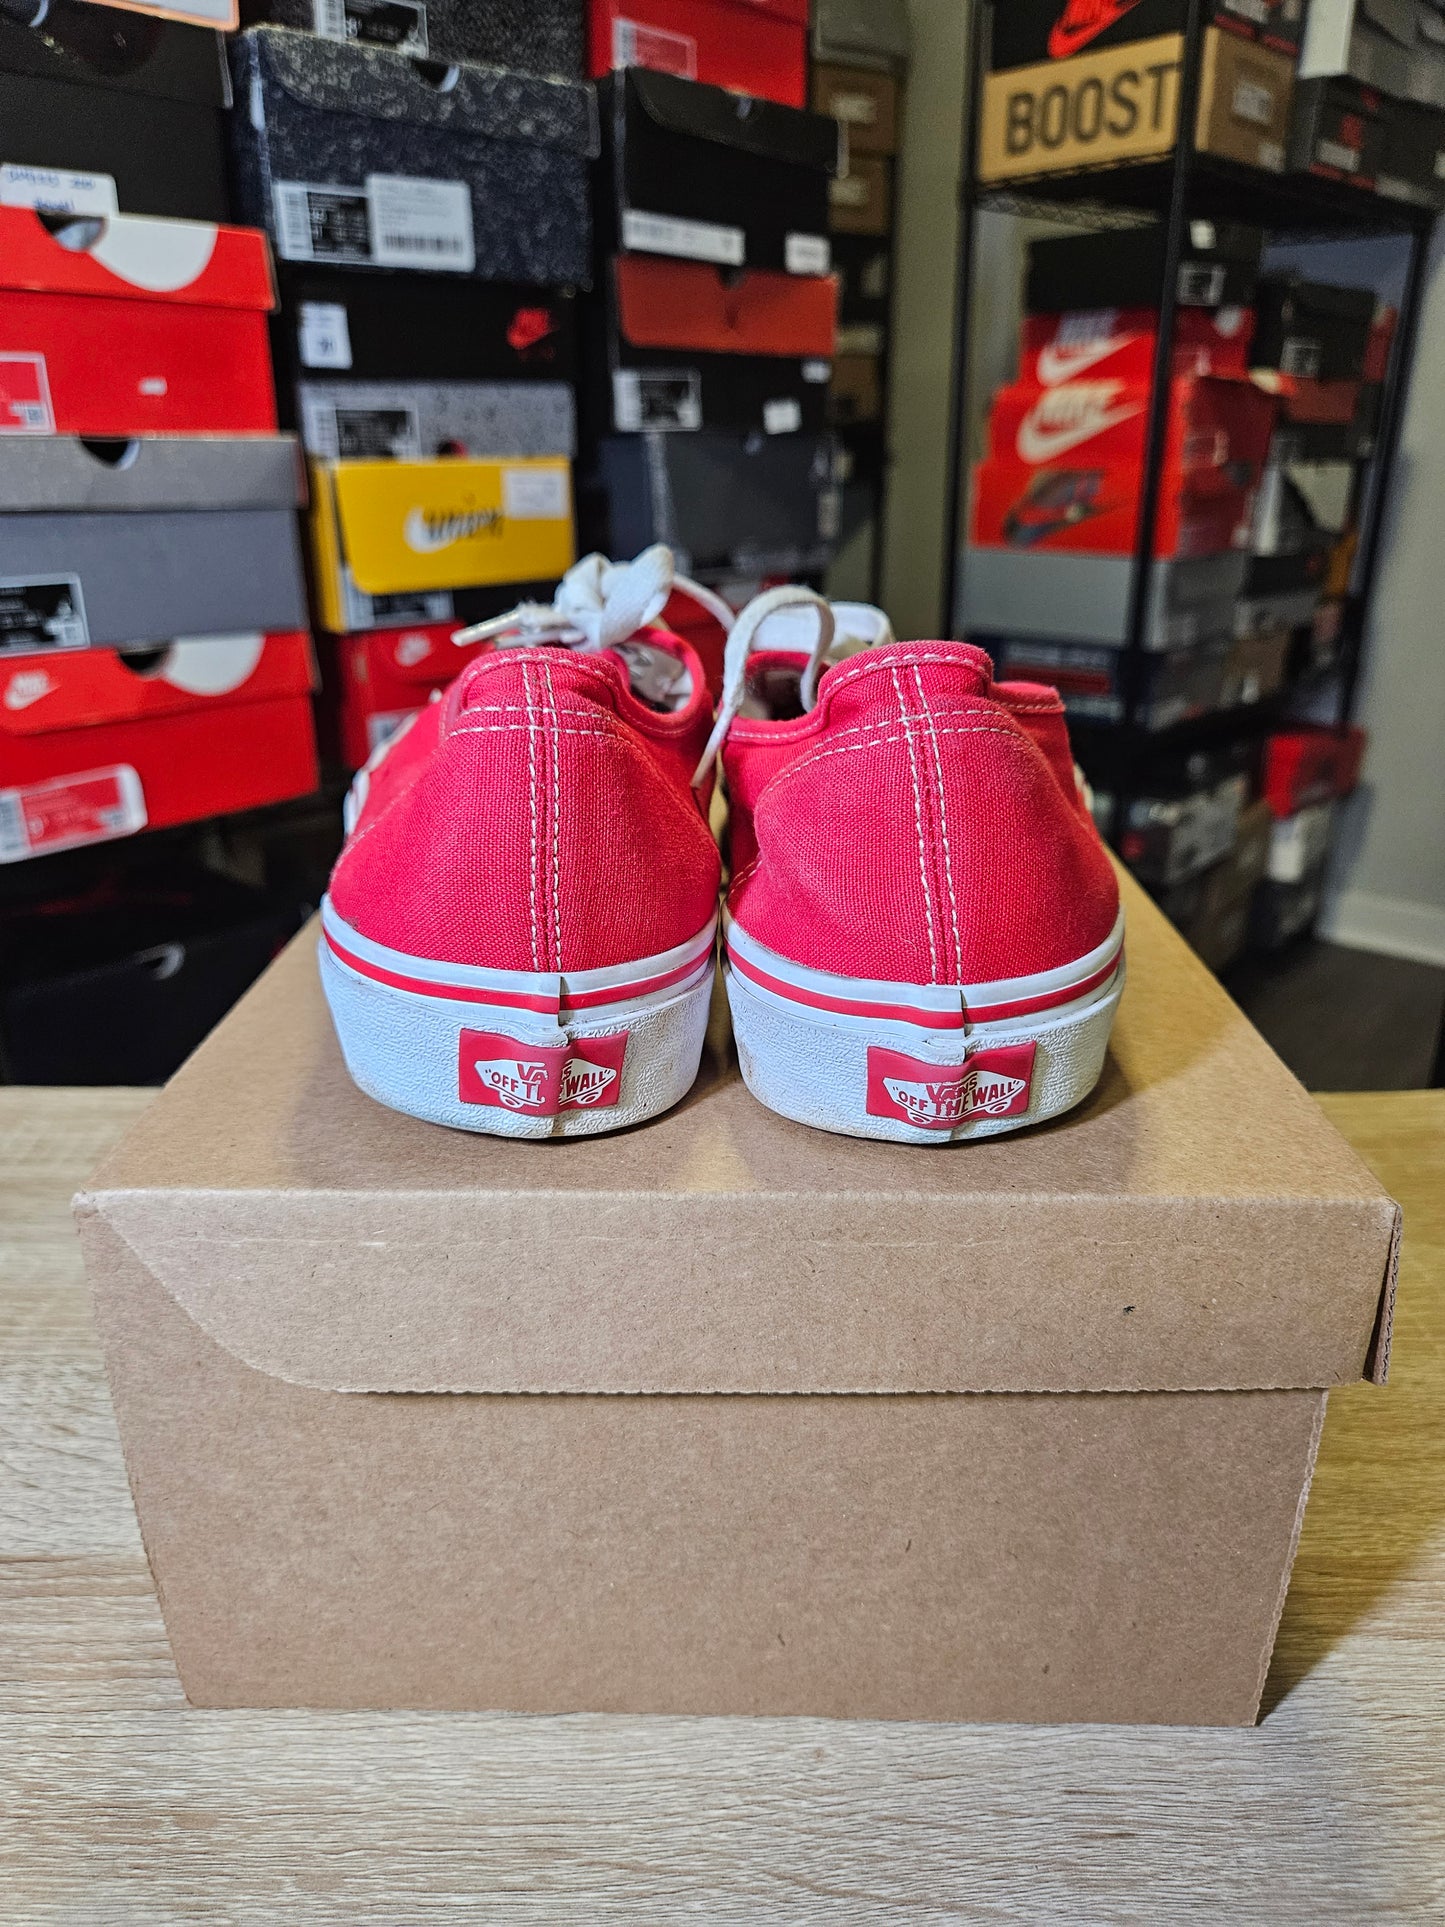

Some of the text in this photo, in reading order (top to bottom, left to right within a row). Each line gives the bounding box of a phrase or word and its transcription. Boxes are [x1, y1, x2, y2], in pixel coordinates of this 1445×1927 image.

[1006, 62, 1181, 155] BOOST
[926, 1073, 978, 1101] VANS
[931, 1092, 970, 1116] THE
